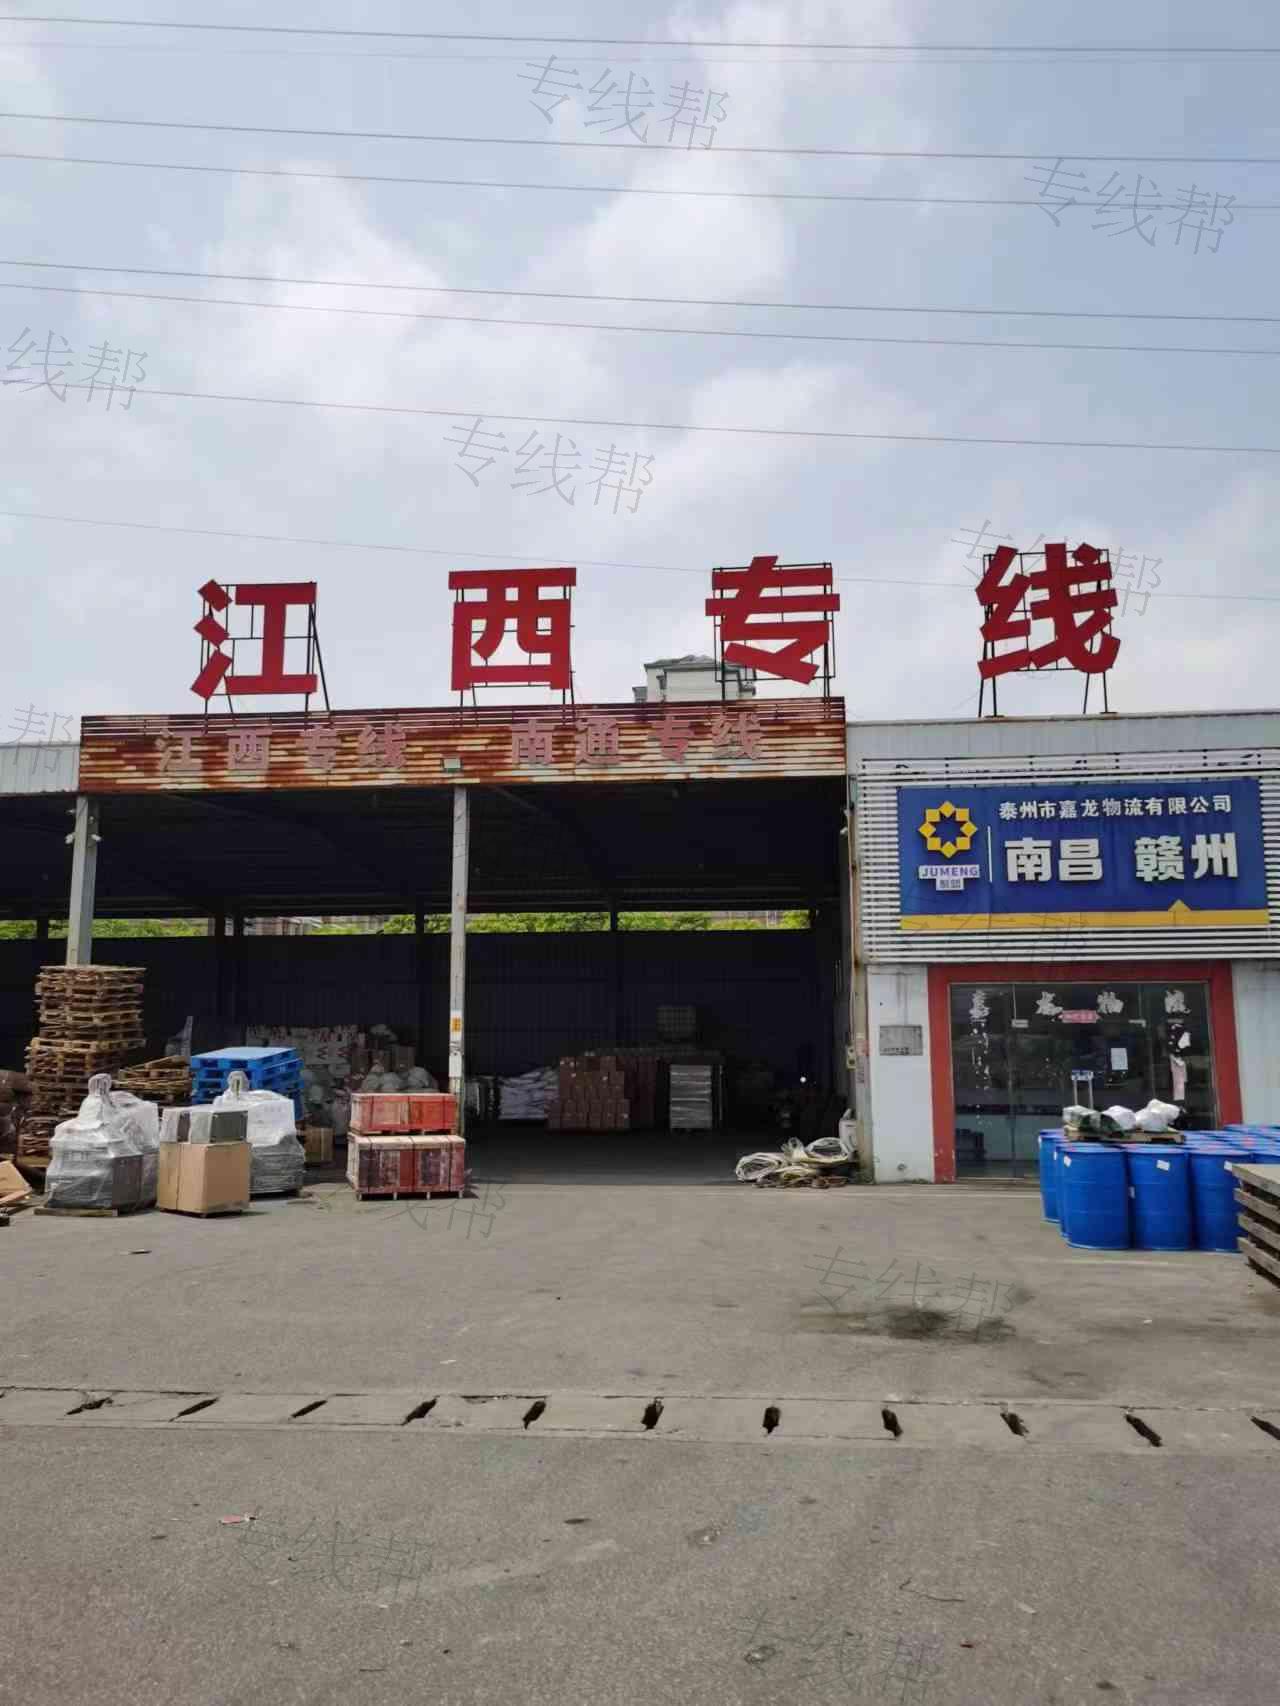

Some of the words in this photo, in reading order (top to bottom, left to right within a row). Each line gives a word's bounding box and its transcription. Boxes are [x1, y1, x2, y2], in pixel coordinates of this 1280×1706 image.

[190, 543, 1121, 700] 江西专线
[155, 722, 407, 773] 江西专线
[512, 709, 762, 768] 南通专线
[999, 795, 1233, 820] 泰州市嘉龙物流有限公司
[921, 866, 978, 877] JUMENG
[1004, 837, 1104, 882] 南昌
[1134, 832, 1239, 882] 赣州
